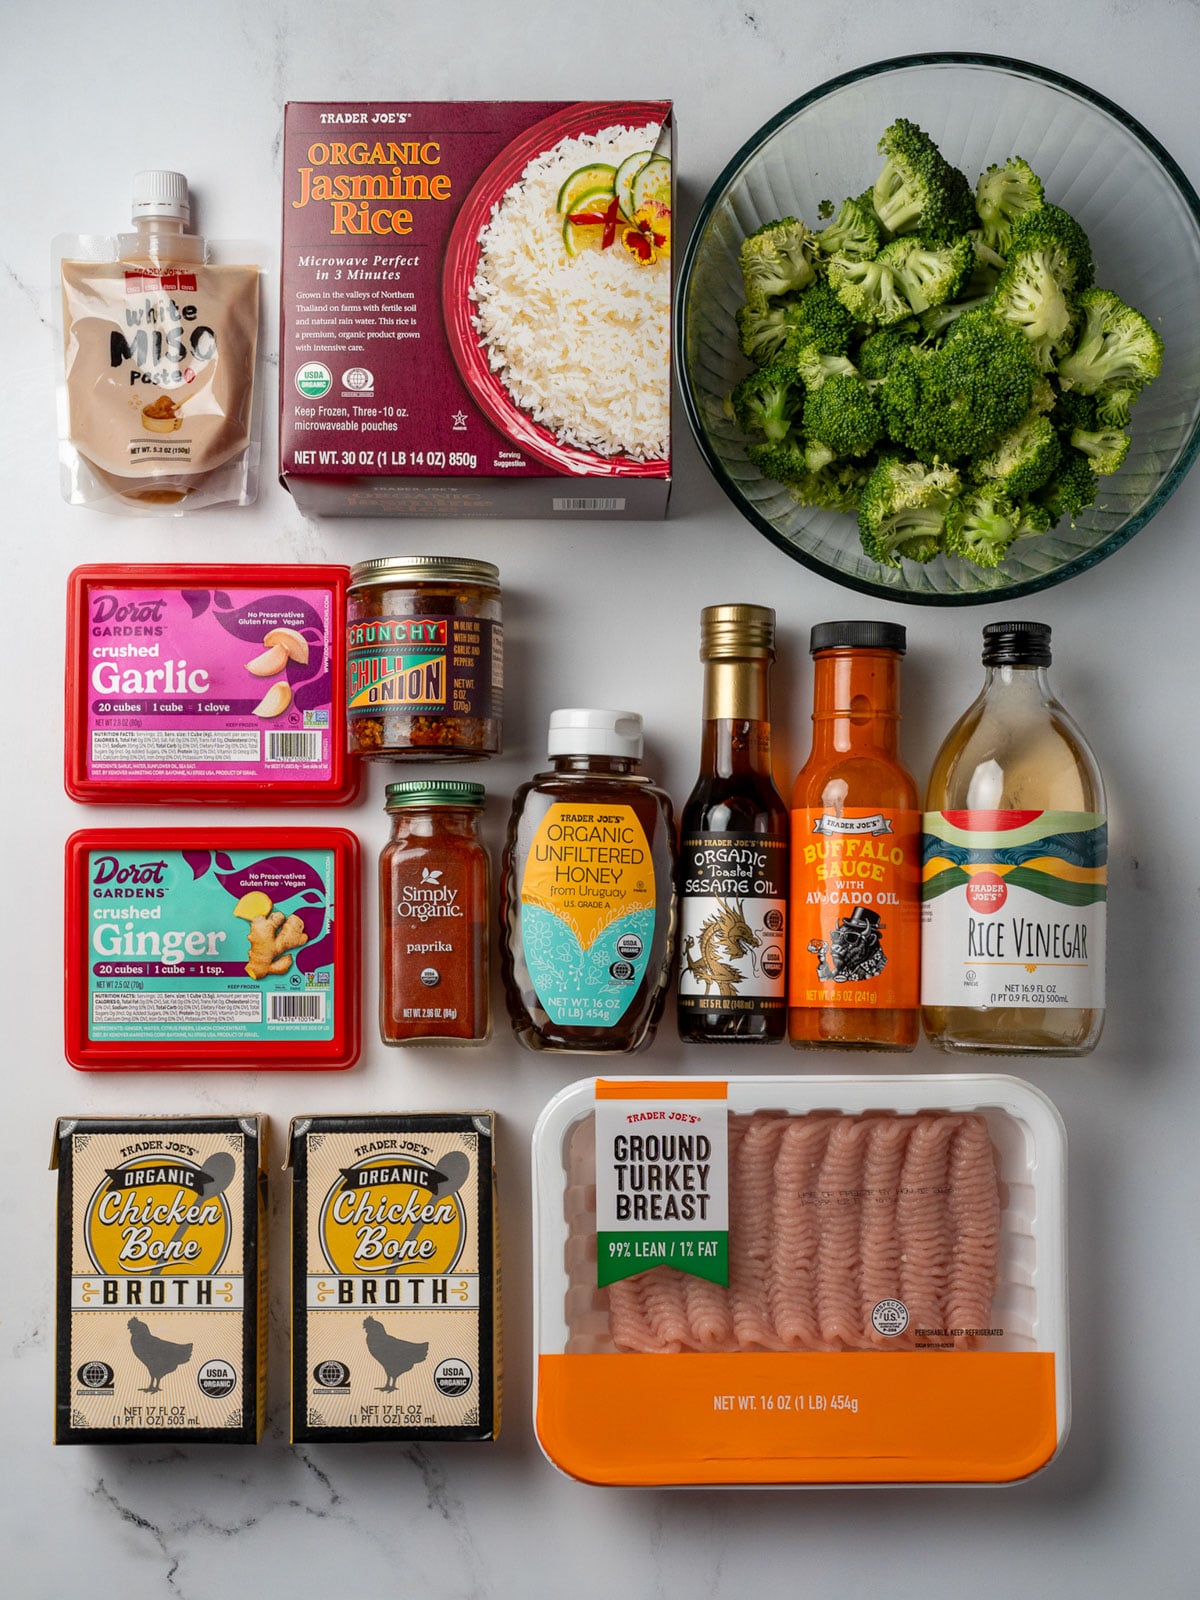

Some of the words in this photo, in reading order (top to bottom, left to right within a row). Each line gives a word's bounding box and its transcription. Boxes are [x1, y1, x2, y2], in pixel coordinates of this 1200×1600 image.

[320, 113, 368, 124] TRADER
[307, 142, 441, 165] ORGANIC
[292, 166, 452, 209] Jasmine
[330, 201, 414, 235] Rice
[298, 256, 369, 267] Microwave
[372, 255, 420, 268] Perfect
[316, 269, 329, 280] in
[334, 270, 342, 280] 3
[346, 270, 402, 280] Minutes
[295, 291, 321, 299] Grown
[322, 291, 331, 299] in
[332, 291, 344, 299] the
[345, 291, 370, 300] valleys
[371, 291, 380, 299] of
[381, 291, 415, 299] Northern
[126, 298, 198, 327] white
[110, 325, 217, 368] MISO
[304, 371, 324, 380] USDA
[294, 406, 316, 418] Keep
[318, 406, 350, 418] Frozen,
[396, 408, 409, 416] oz.
[294, 420, 359, 431] microwaveable
[361, 420, 398, 433] pouches
[294, 451, 317, 464] NET
[318, 451, 339, 464] WT.
[341, 451, 357, 464] 30
[359, 451, 374, 464] OZ
[377, 451, 388, 467] (1
[391, 451, 407, 464] LB
[409, 451, 424, 465] 14
[426, 451, 446, 467] OZ)
[448, 452, 477, 468] 850g
[498, 452, 521, 460] Serving
[493, 460, 526, 469] Suggestion
[92, 594, 167, 623] Dorot
[282, 618, 305, 627] Vegan
[92, 626, 164, 637] GARDENS
[349, 624, 438, 645] CRUNCHY
[92, 643, 159, 658] crushed
[453, 657, 475, 667] PEPPERS
[91, 659, 210, 694] Garlic
[349, 656, 403, 699] CHILI
[369, 660, 441, 703] ONION
[98, 703, 111, 712] 20
[113, 702, 141, 712] cubes
[152, 703, 159, 712] 1
[160, 702, 184, 712] cube
[197, 703, 203, 712] 1
[204, 702, 230, 712] clove
[560, 814, 594, 823] TRADER
[826, 819, 855, 830] TRADER
[547, 824, 634, 844] ORGANIC
[704, 839, 732, 847] TRADER
[535, 845, 644, 865] UNFILTERED
[694, 848, 767, 868] ORGANIC
[803, 839, 904, 866] BUFFALO
[93, 856, 168, 885] Dorot
[249, 872, 259, 880] No
[260, 872, 306, 880] Preservatives
[555, 865, 623, 884] HONEY
[707, 863, 753, 878] Toasted
[815, 860, 886, 882] SAUCE
[240, 879, 263, 887] Gluten
[264, 879, 279, 887] Free
[283, 880, 306, 889] Vegan
[685, 879, 749, 893] SESAME
[753, 880, 777, 895] OIL
[835, 880, 864, 889] WITH
[969, 884, 1004, 893] TRADER
[93, 888, 165, 898] GARDENS
[402, 885, 458, 906] Simply
[550, 885, 577, 897] from
[579, 885, 627, 899] Uruguay
[805, 892, 873, 905] AVOCADO
[876, 892, 900, 905] OIL
[93, 905, 161, 919] crushed
[578, 901, 603, 909] GRADE
[92, 922, 227, 965] Ginger
[406, 941, 453, 954] paprika
[1004, 984, 1020, 992] NET
[1021, 984, 1035, 993] 16.9
[1036, 984, 1045, 993] FL
[1046, 984, 1057, 993] OZ
[547, 997, 568, 1007] NET
[570, 998, 591, 1008] WT.
[593, 998, 602, 1008] 16
[604, 999, 620, 1009] OZ
[557, 1008, 566, 1019] (1
[567, 1008, 584, 1019] LB)
[585, 1009, 610, 1021] 454g
[626, 1111, 666, 1123] TRADER
[120, 1140, 163, 1157] TRADER
[354, 1139, 397, 1157] TRADER
[613, 1134, 712, 1162] GROUND
[124, 1168, 194, 1187] ORGANIC
[358, 1167, 429, 1186] ORGANIC
[613, 1164, 711, 1192] TURKEY
[98, 1189, 222, 1226] Chicken
[332, 1188, 457, 1225] Chicken
[616, 1193, 711, 1221] BREAST
[118, 1225, 202, 1261] Bone
[353, 1225, 437, 1260] Bone
[608, 1242, 631, 1257] 99%
[635, 1242, 666, 1257] LEAN
[679, 1242, 694, 1257] 1%
[698, 1241, 718, 1257] FAT
[103, 1279, 212, 1305] BROTH
[338, 1278, 448, 1304] BROTH
[874, 1300, 905, 1316] INSPECTED
[883, 1312, 898, 1322] U.S.
[965, 1329, 1004, 1337] REFRIGERATED
[206, 1369, 228, 1378] USDA
[442, 1367, 464, 1377] USDA
[203, 1380, 231, 1388] ORGANIC
[439, 1379, 468, 1387] ORGANIC
[123, 1406, 142, 1415] NET
[146, 1406, 156, 1415] 17
[159, 1406, 169, 1415] FL
[171, 1406, 185, 1415] OZ
[713, 1396, 736, 1410] NET
[738, 1396, 756, 1410] WT.
[760, 1396, 774, 1410] 16
[777, 1396, 792, 1410] OZ
[795, 1395, 805, 1411] (1
[808, 1396, 827, 1411] LB)
[830, 1395, 859, 1413] 454g
